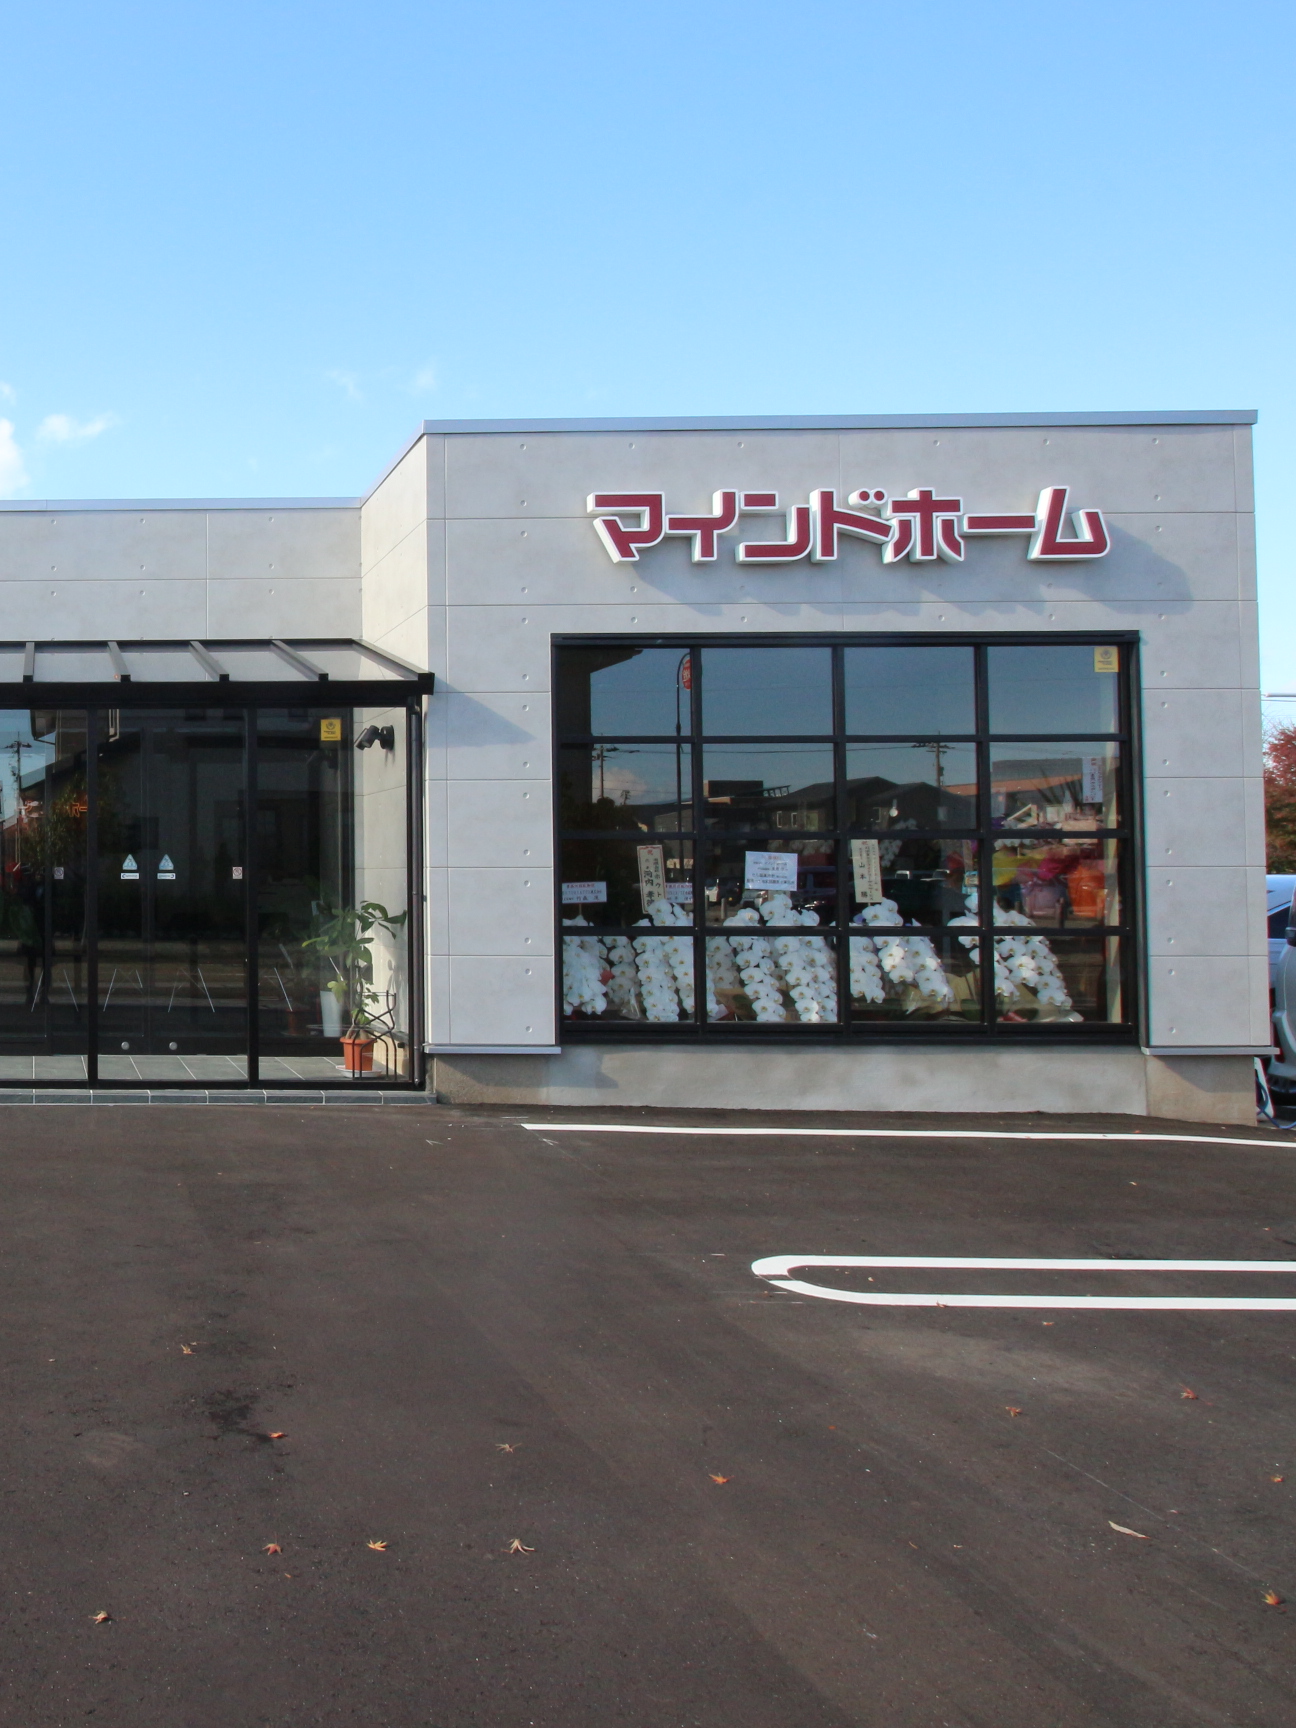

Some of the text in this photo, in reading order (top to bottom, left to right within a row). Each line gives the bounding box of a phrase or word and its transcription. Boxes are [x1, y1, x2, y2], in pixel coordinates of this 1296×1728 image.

[588, 486, 1111, 563] マインドホーム
